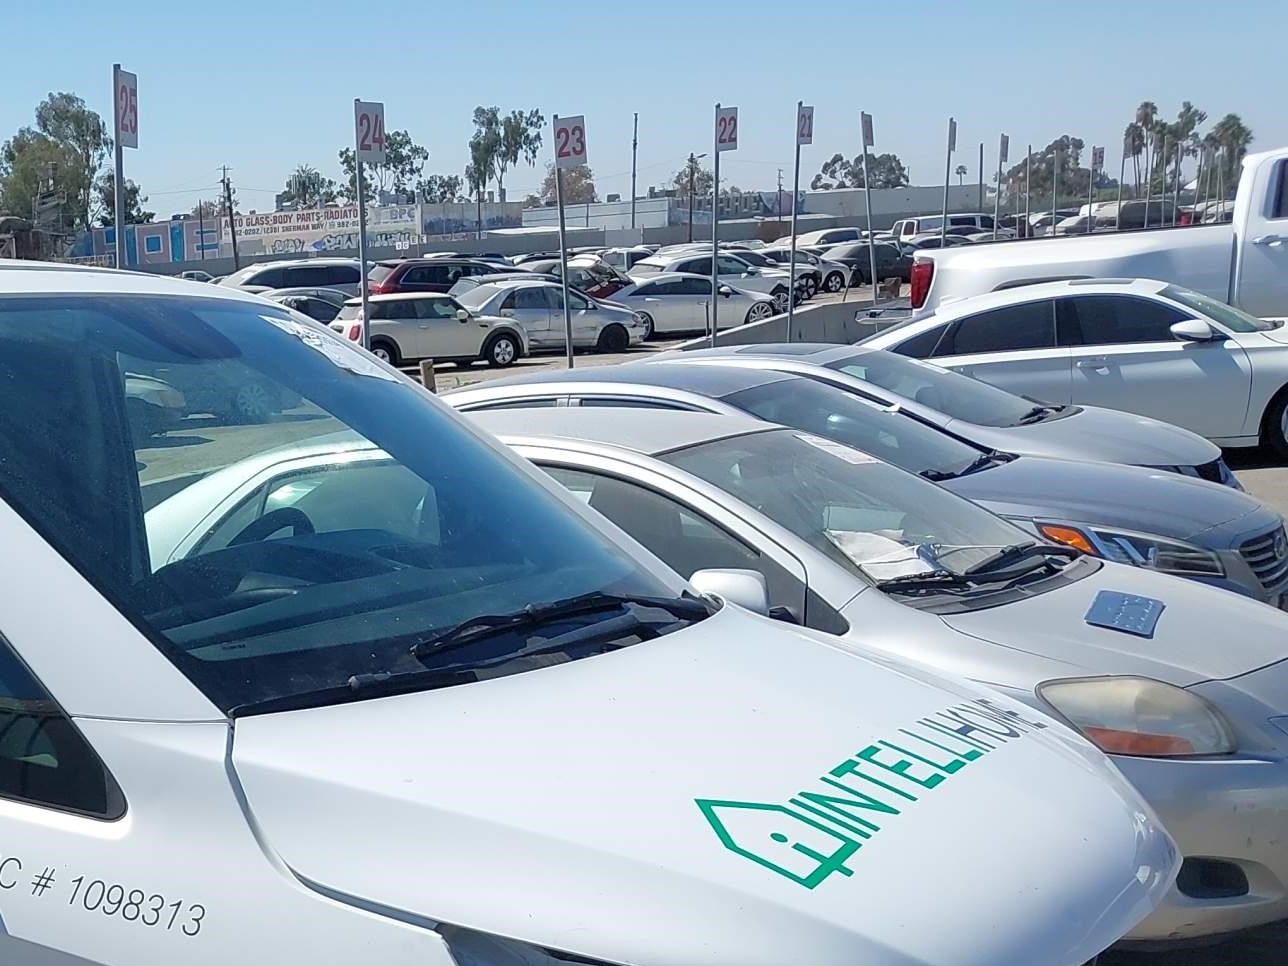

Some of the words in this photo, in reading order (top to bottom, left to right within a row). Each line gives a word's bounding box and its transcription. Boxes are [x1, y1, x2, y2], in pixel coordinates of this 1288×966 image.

[119, 84, 137, 135] 25
[799, 113, 812, 138] 21
[359, 112, 383, 152] 24
[556, 125, 585, 158] 23
[718, 115, 737, 144] 22
[224, 217, 244, 228] ATO
[31, 867, 56, 897] #
[69, 875, 206, 936] 1098313
